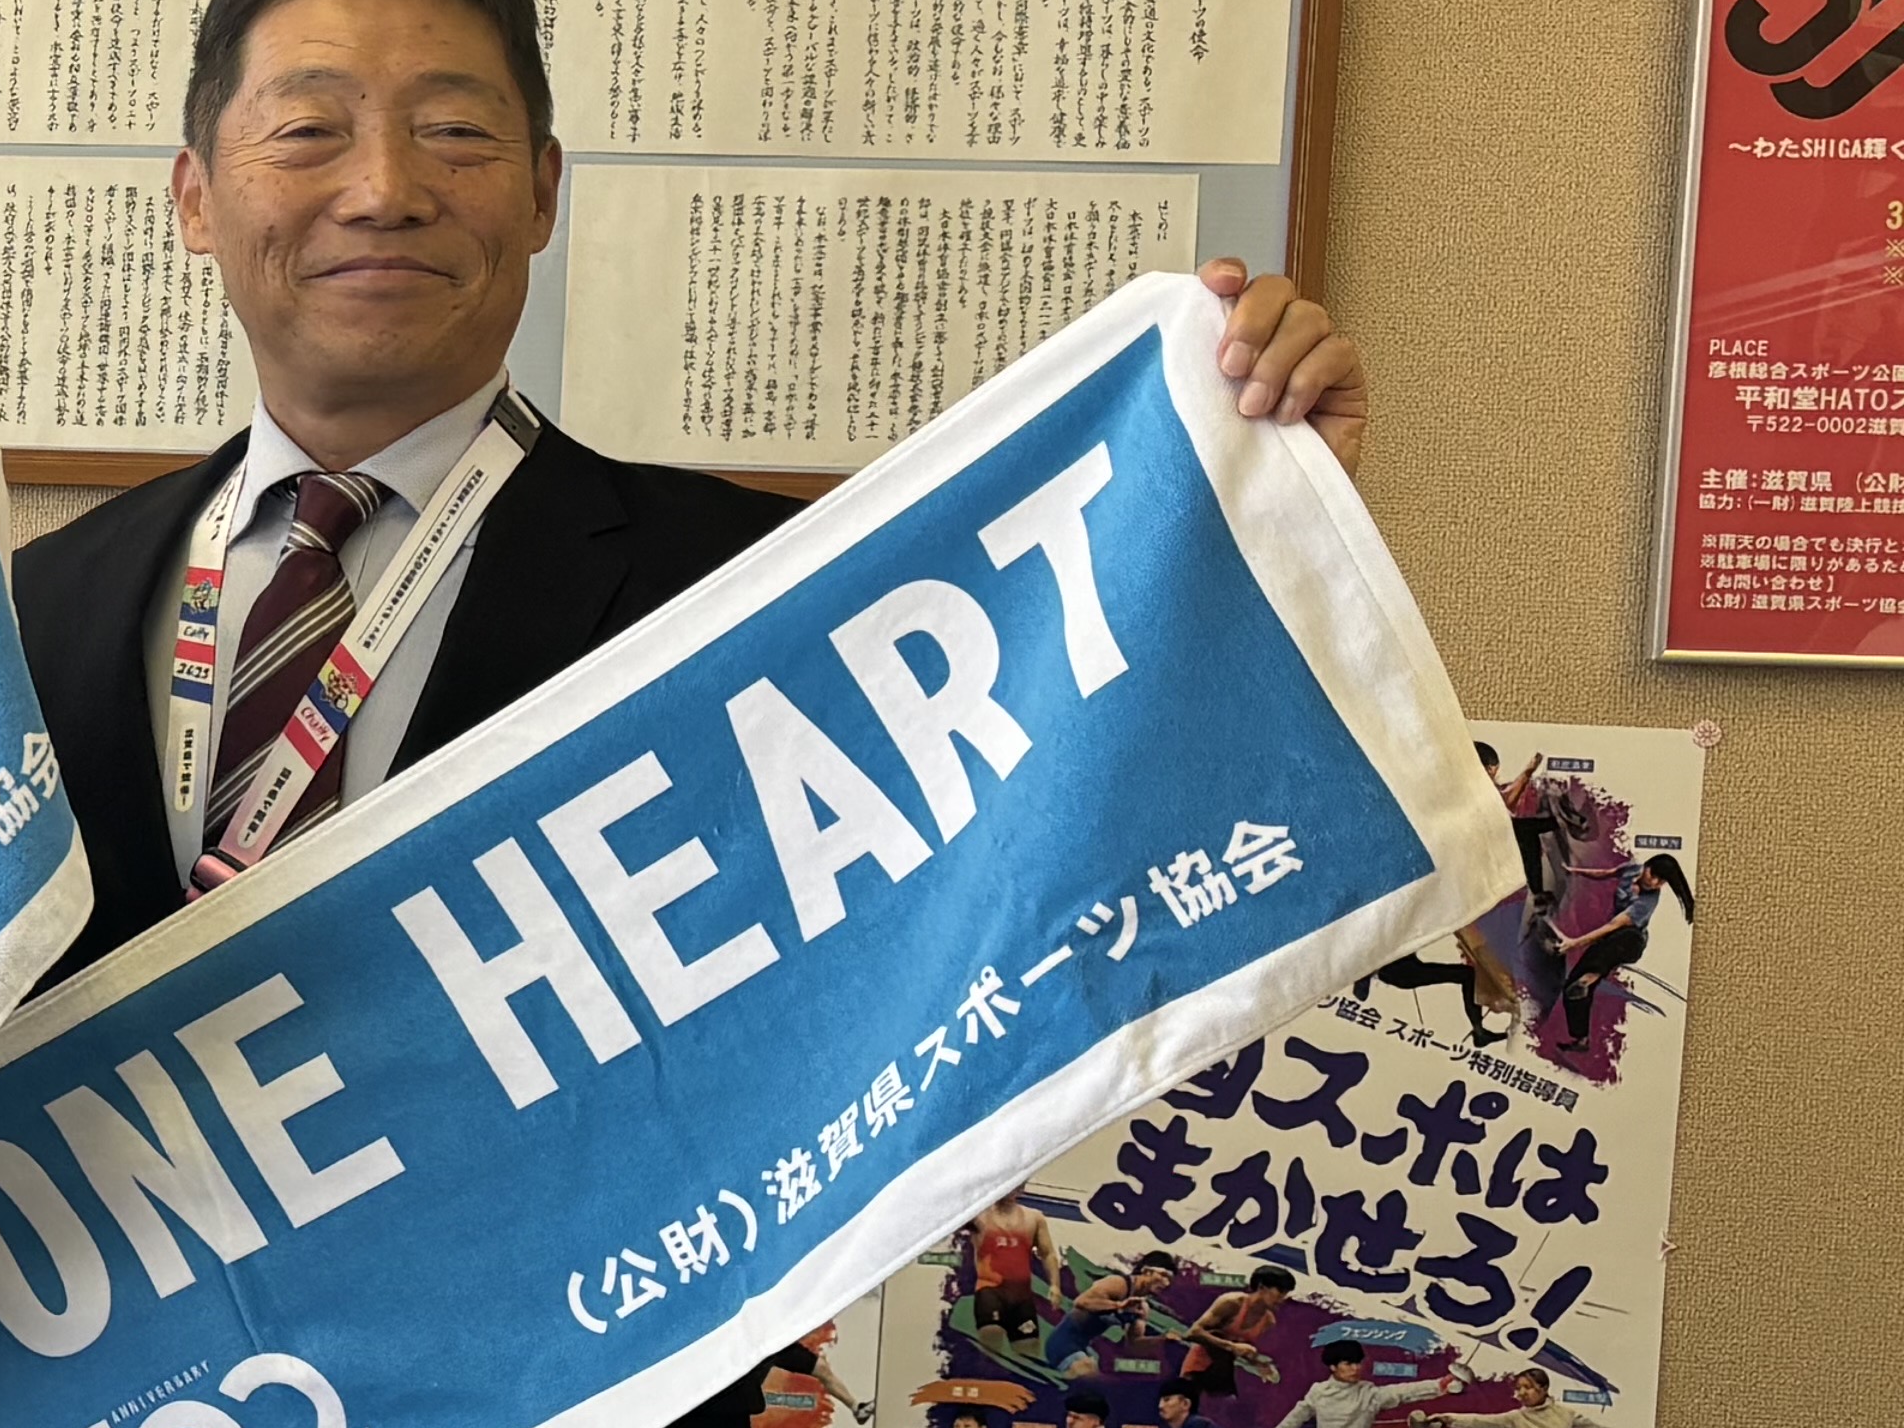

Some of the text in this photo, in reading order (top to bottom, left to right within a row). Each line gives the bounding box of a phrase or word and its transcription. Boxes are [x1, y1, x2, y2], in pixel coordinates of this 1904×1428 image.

[1709, 339, 1769, 356] PLACE
[390, 440, 1130, 1113] HEART
[566, 817, 1305, 1336] (公財)滋賀県スポーツ協会
[1386, 1016, 1581, 1114] スポーツ特別指導員
[1088, 1114, 1594, 1348] まかせろ!
[1341, 1325, 1408, 1341] フェンシング
[110, 1358, 214, 1426] ANNIVERSARY
